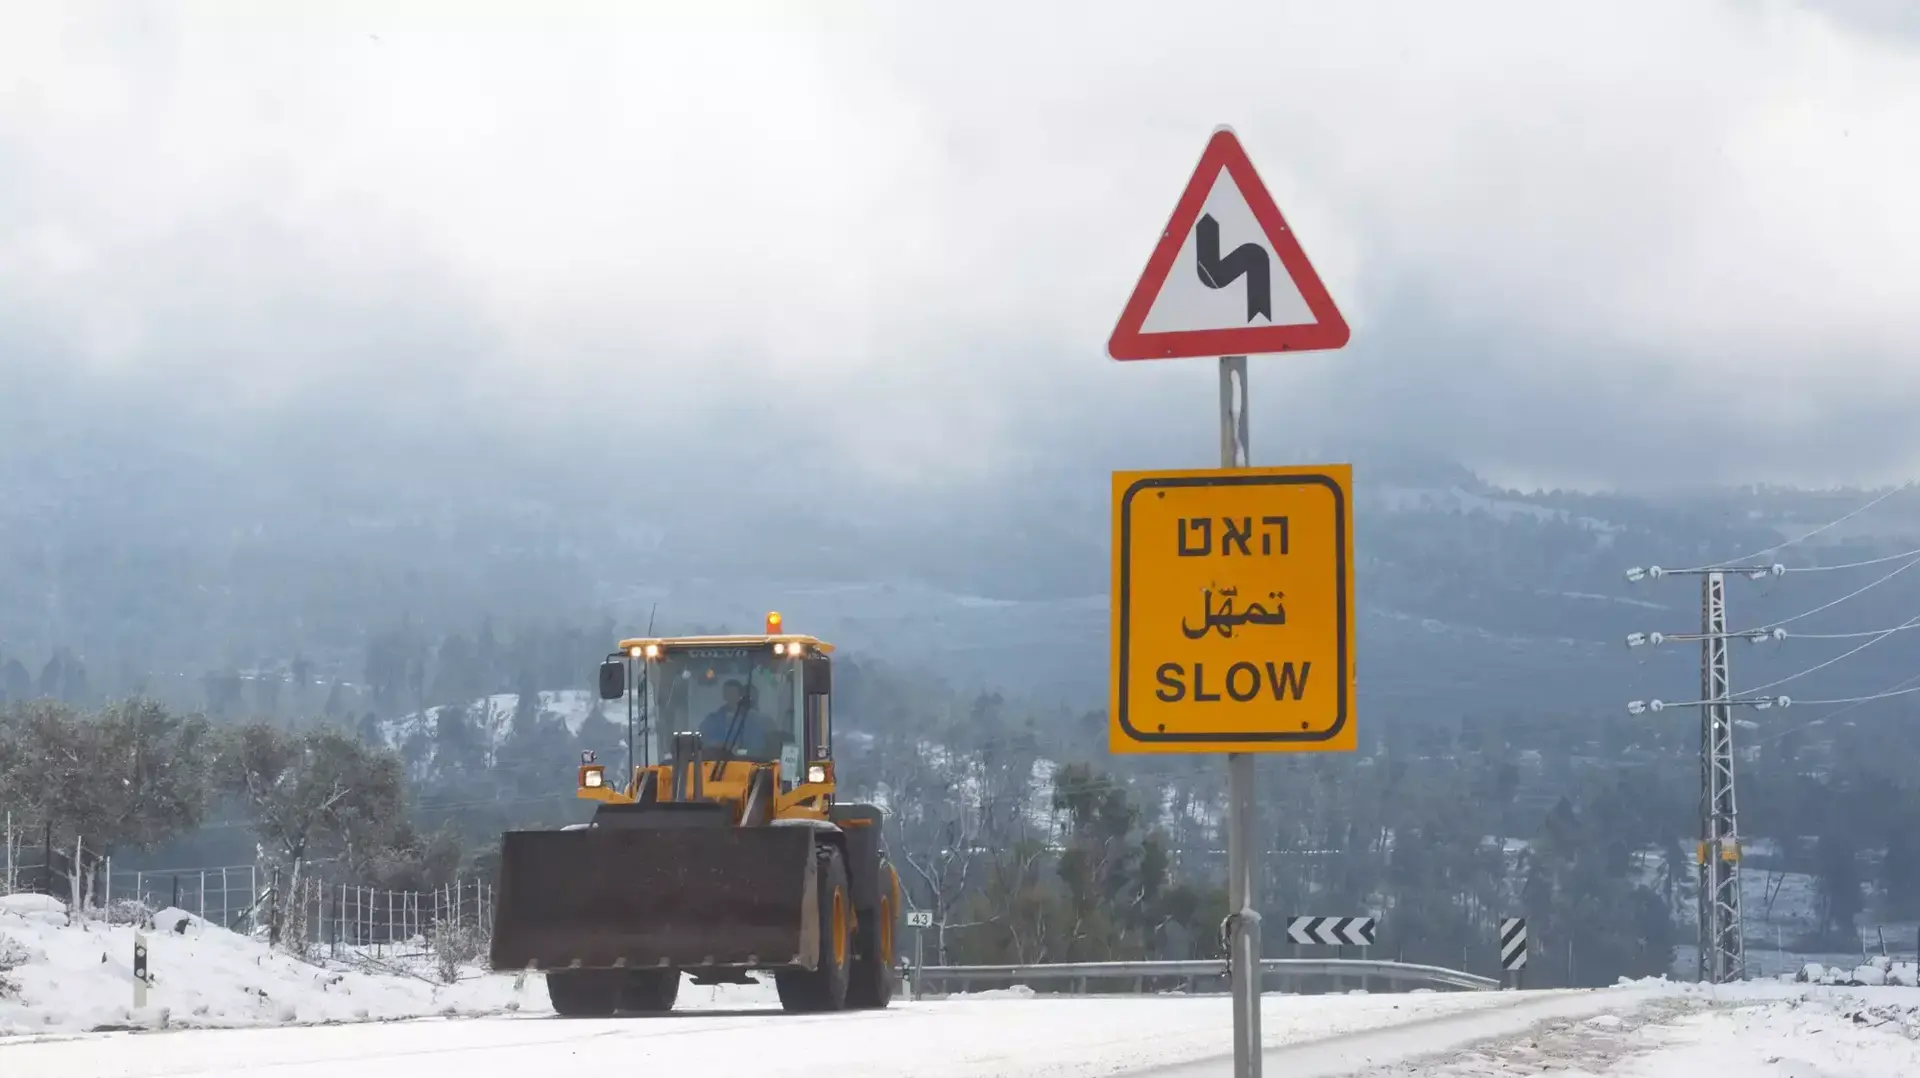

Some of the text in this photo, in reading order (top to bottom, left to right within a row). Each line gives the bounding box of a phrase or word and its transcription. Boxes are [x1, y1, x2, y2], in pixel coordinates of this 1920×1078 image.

[1178, 516, 1289, 557] האט
[1155, 661, 1312, 703] SLOW
[912, 914, 928, 925] 43
